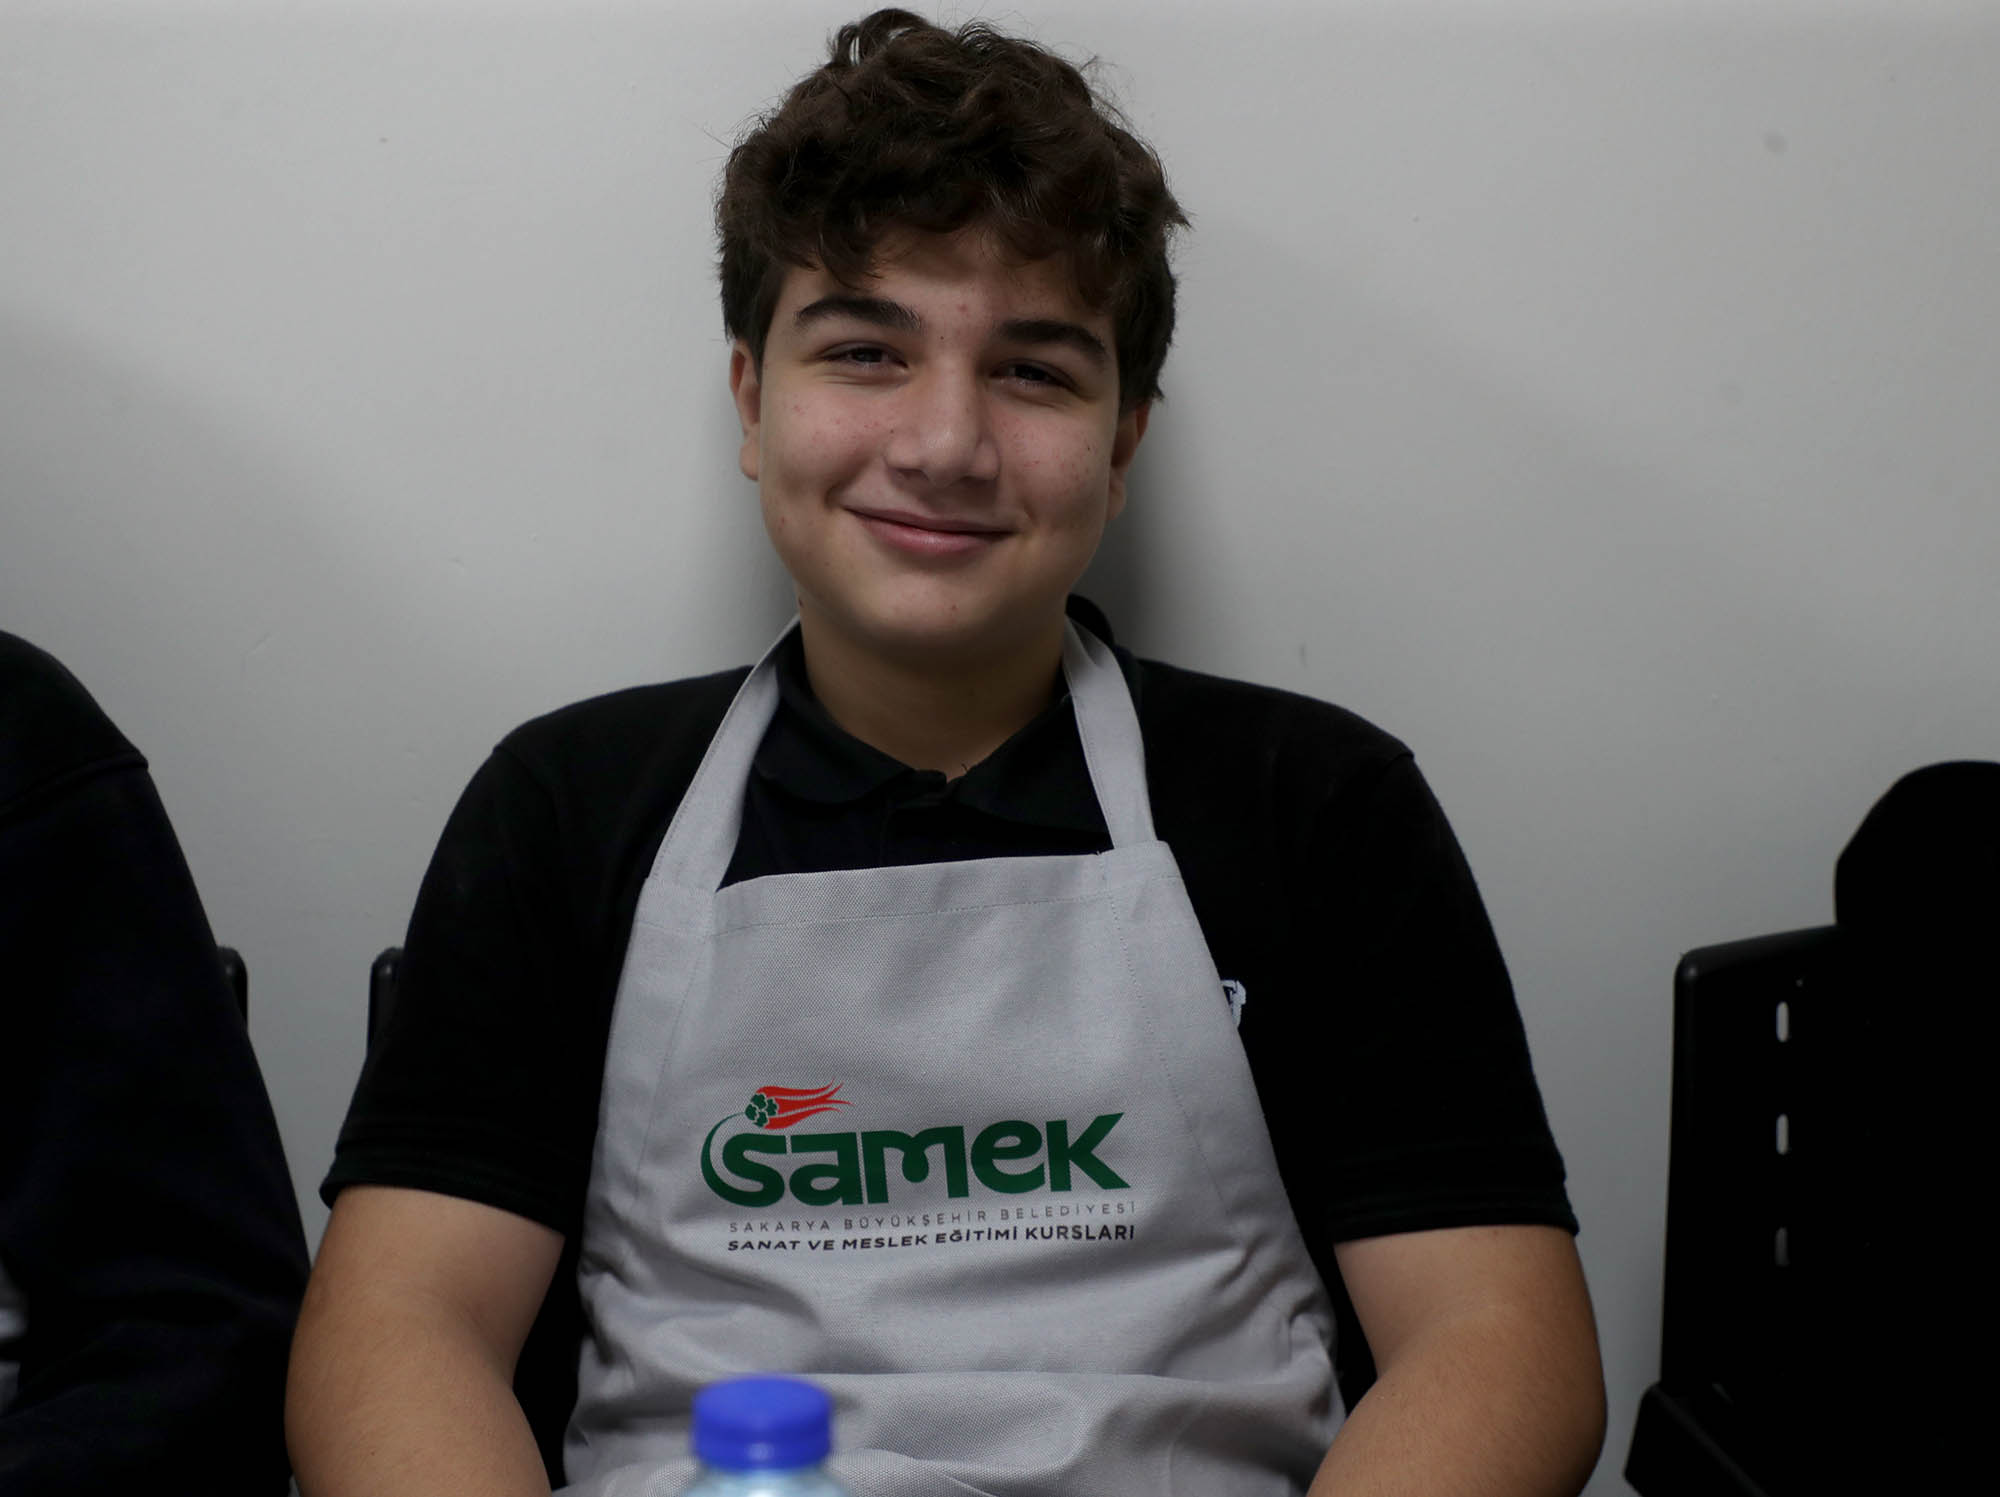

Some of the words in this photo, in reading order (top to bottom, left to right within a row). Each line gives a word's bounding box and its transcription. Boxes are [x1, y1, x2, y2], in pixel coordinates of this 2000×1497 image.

[729, 1219, 830, 1233] SAKARYA
[844, 1209, 987, 1231] BÜYÜKŞEHİR
[1000, 1201, 1135, 1221] BELEDİYESİ
[727, 1239, 801, 1251] SANAT
[808, 1239, 835, 1251] VE
[842, 1234, 928, 1250] MESLEK
[935, 1226, 1018, 1244] EĞİTİMİ
[1025, 1224, 1135, 1241] KURSLARI
